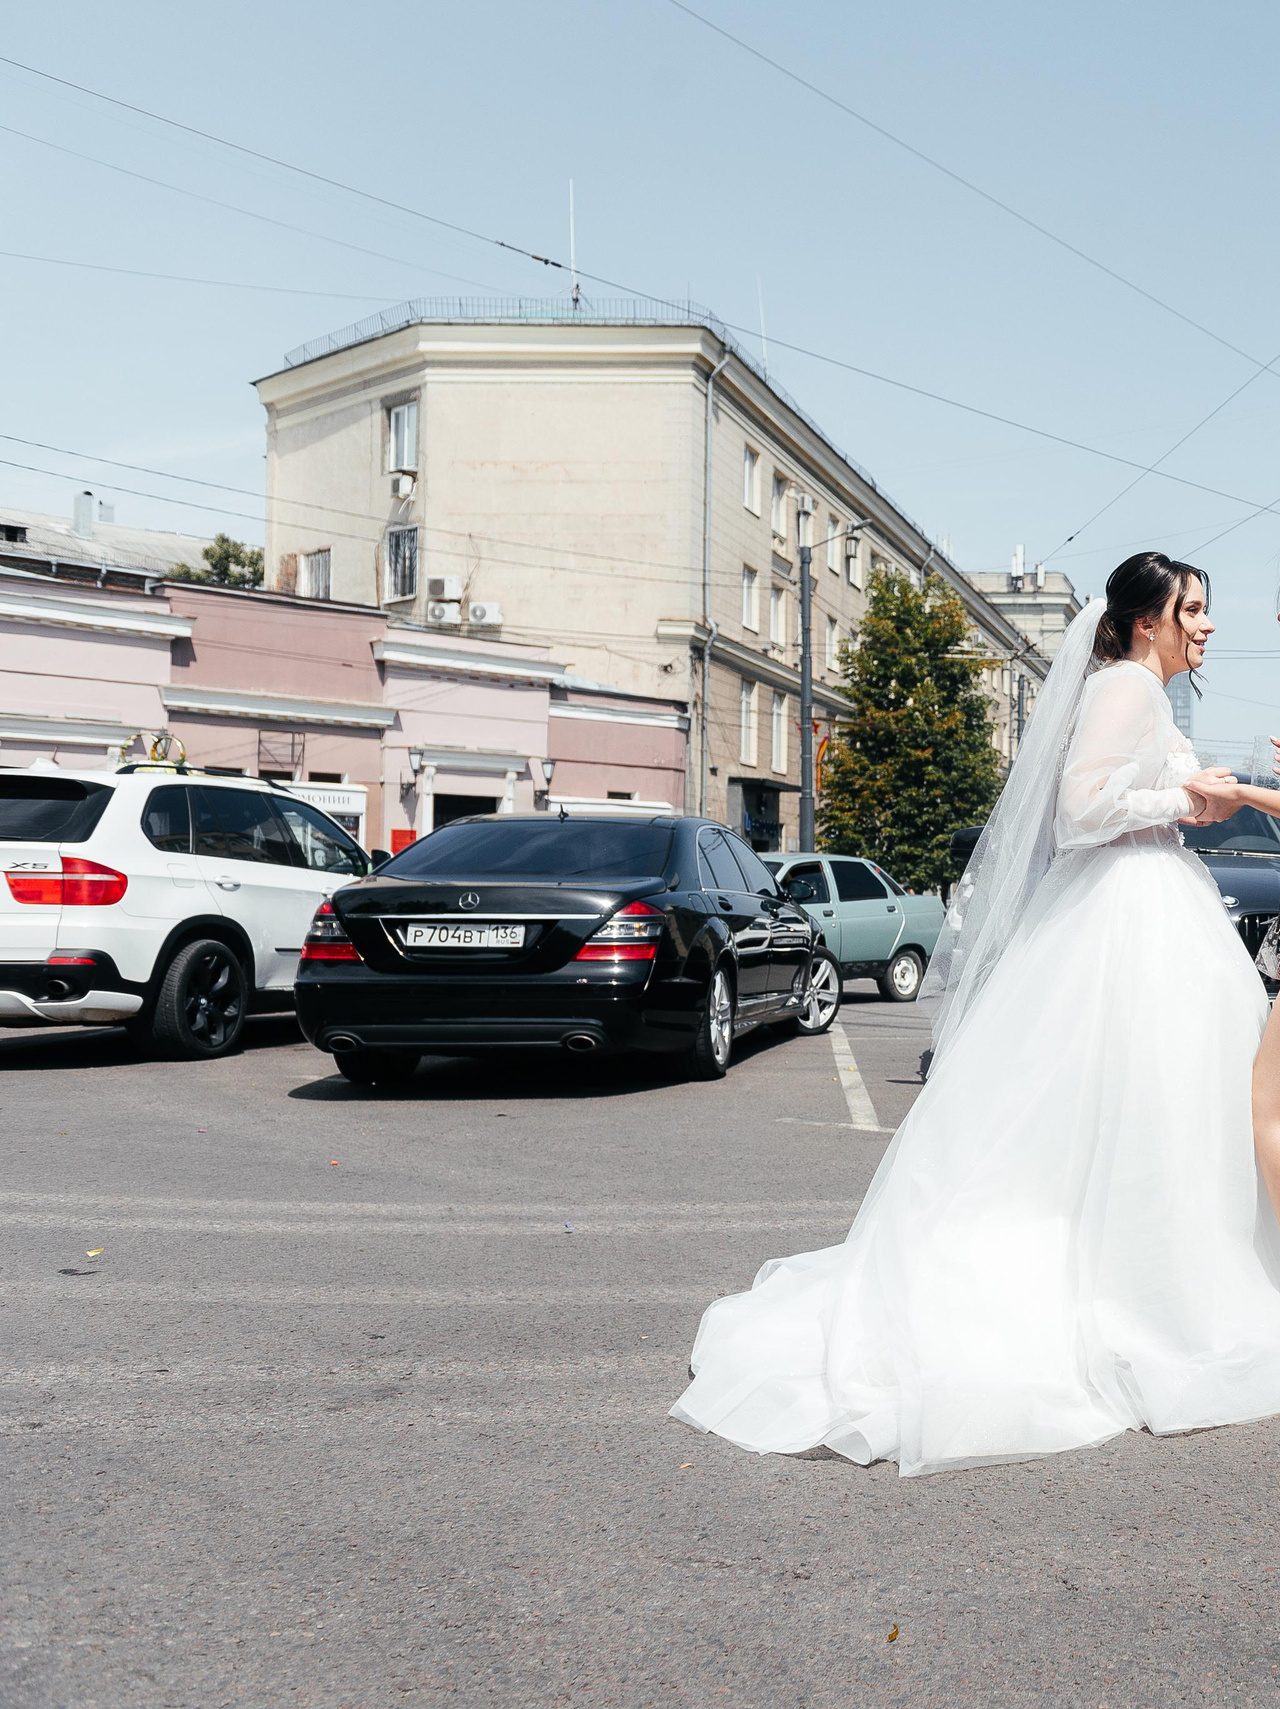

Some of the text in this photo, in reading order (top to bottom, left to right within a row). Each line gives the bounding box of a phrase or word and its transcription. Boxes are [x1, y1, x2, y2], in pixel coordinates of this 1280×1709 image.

[298, 793, 351, 805] МОНИИ
[9, 861, 49, 870] X5
[491, 925, 518, 940] 136
